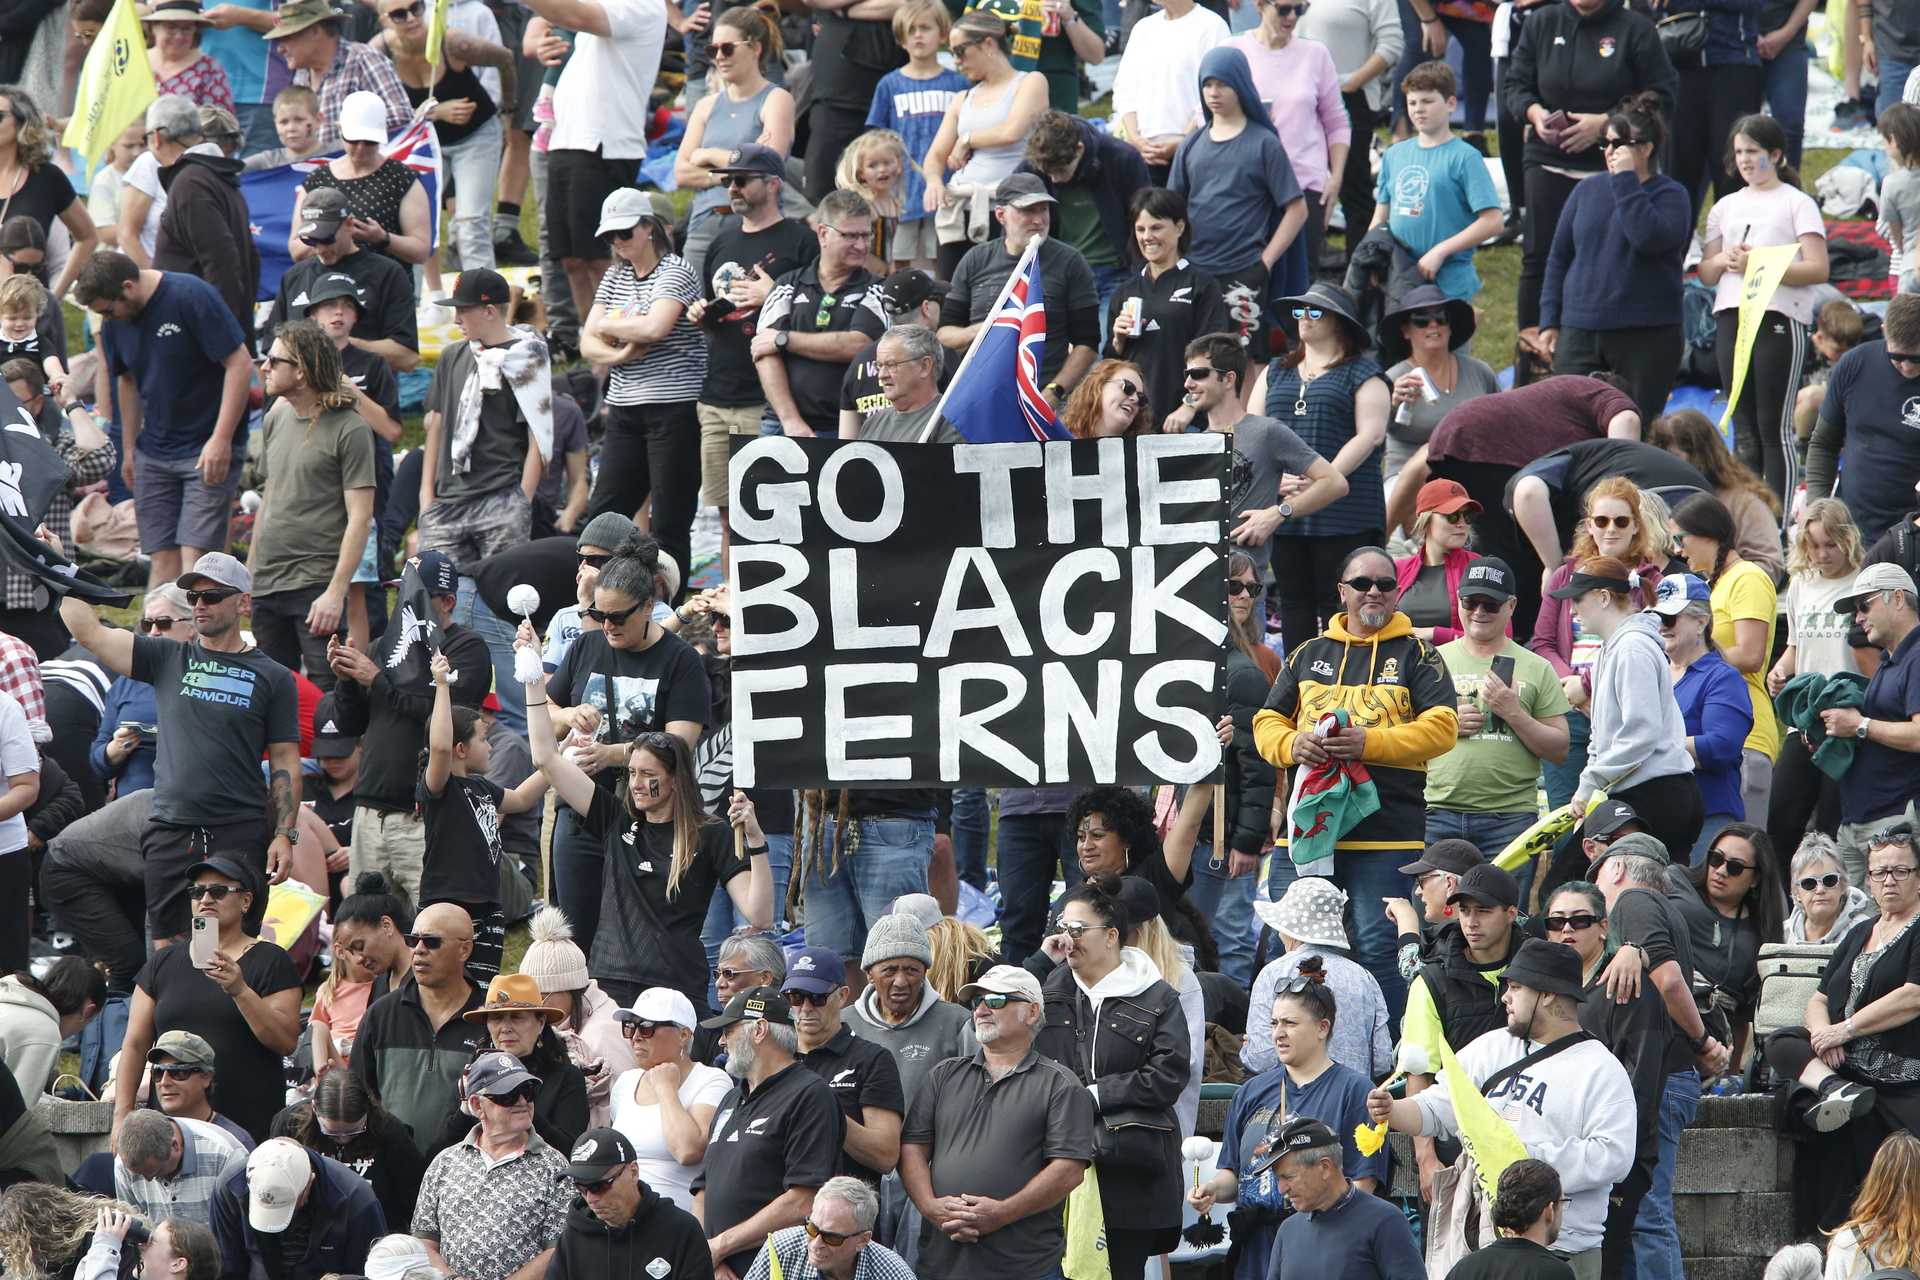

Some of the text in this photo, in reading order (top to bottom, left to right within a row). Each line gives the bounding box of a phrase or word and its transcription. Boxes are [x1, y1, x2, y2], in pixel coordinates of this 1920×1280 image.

[728, 435, 905, 545] GO
[953, 433, 1225, 549] THE
[729, 544, 1228, 657] BLACK
[179, 687, 251, 709] ARMOUR
[188, 658, 257, 682] UNDER
[731, 660, 1223, 788] FERNS
[1487, 1074, 1548, 1117] USA
